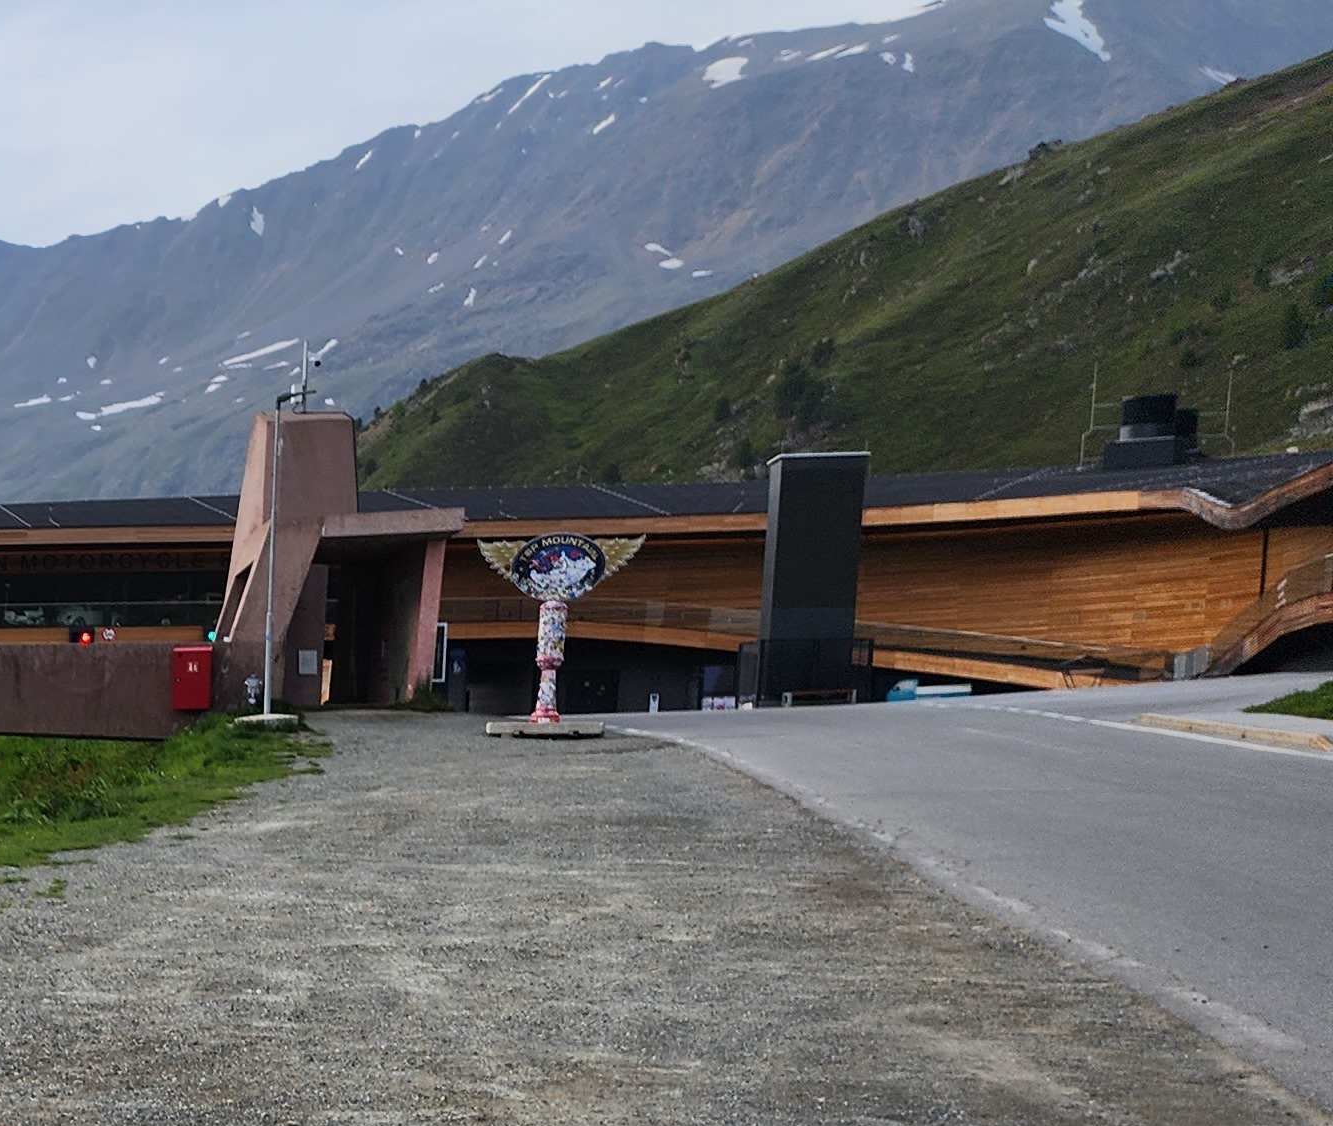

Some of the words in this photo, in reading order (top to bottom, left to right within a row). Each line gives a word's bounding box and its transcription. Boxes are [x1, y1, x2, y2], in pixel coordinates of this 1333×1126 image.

[520, 544, 539, 561] TOP
[541, 536, 599, 560] MOUNTAIN
[20, 552, 206, 571] MOTORCYCLE
